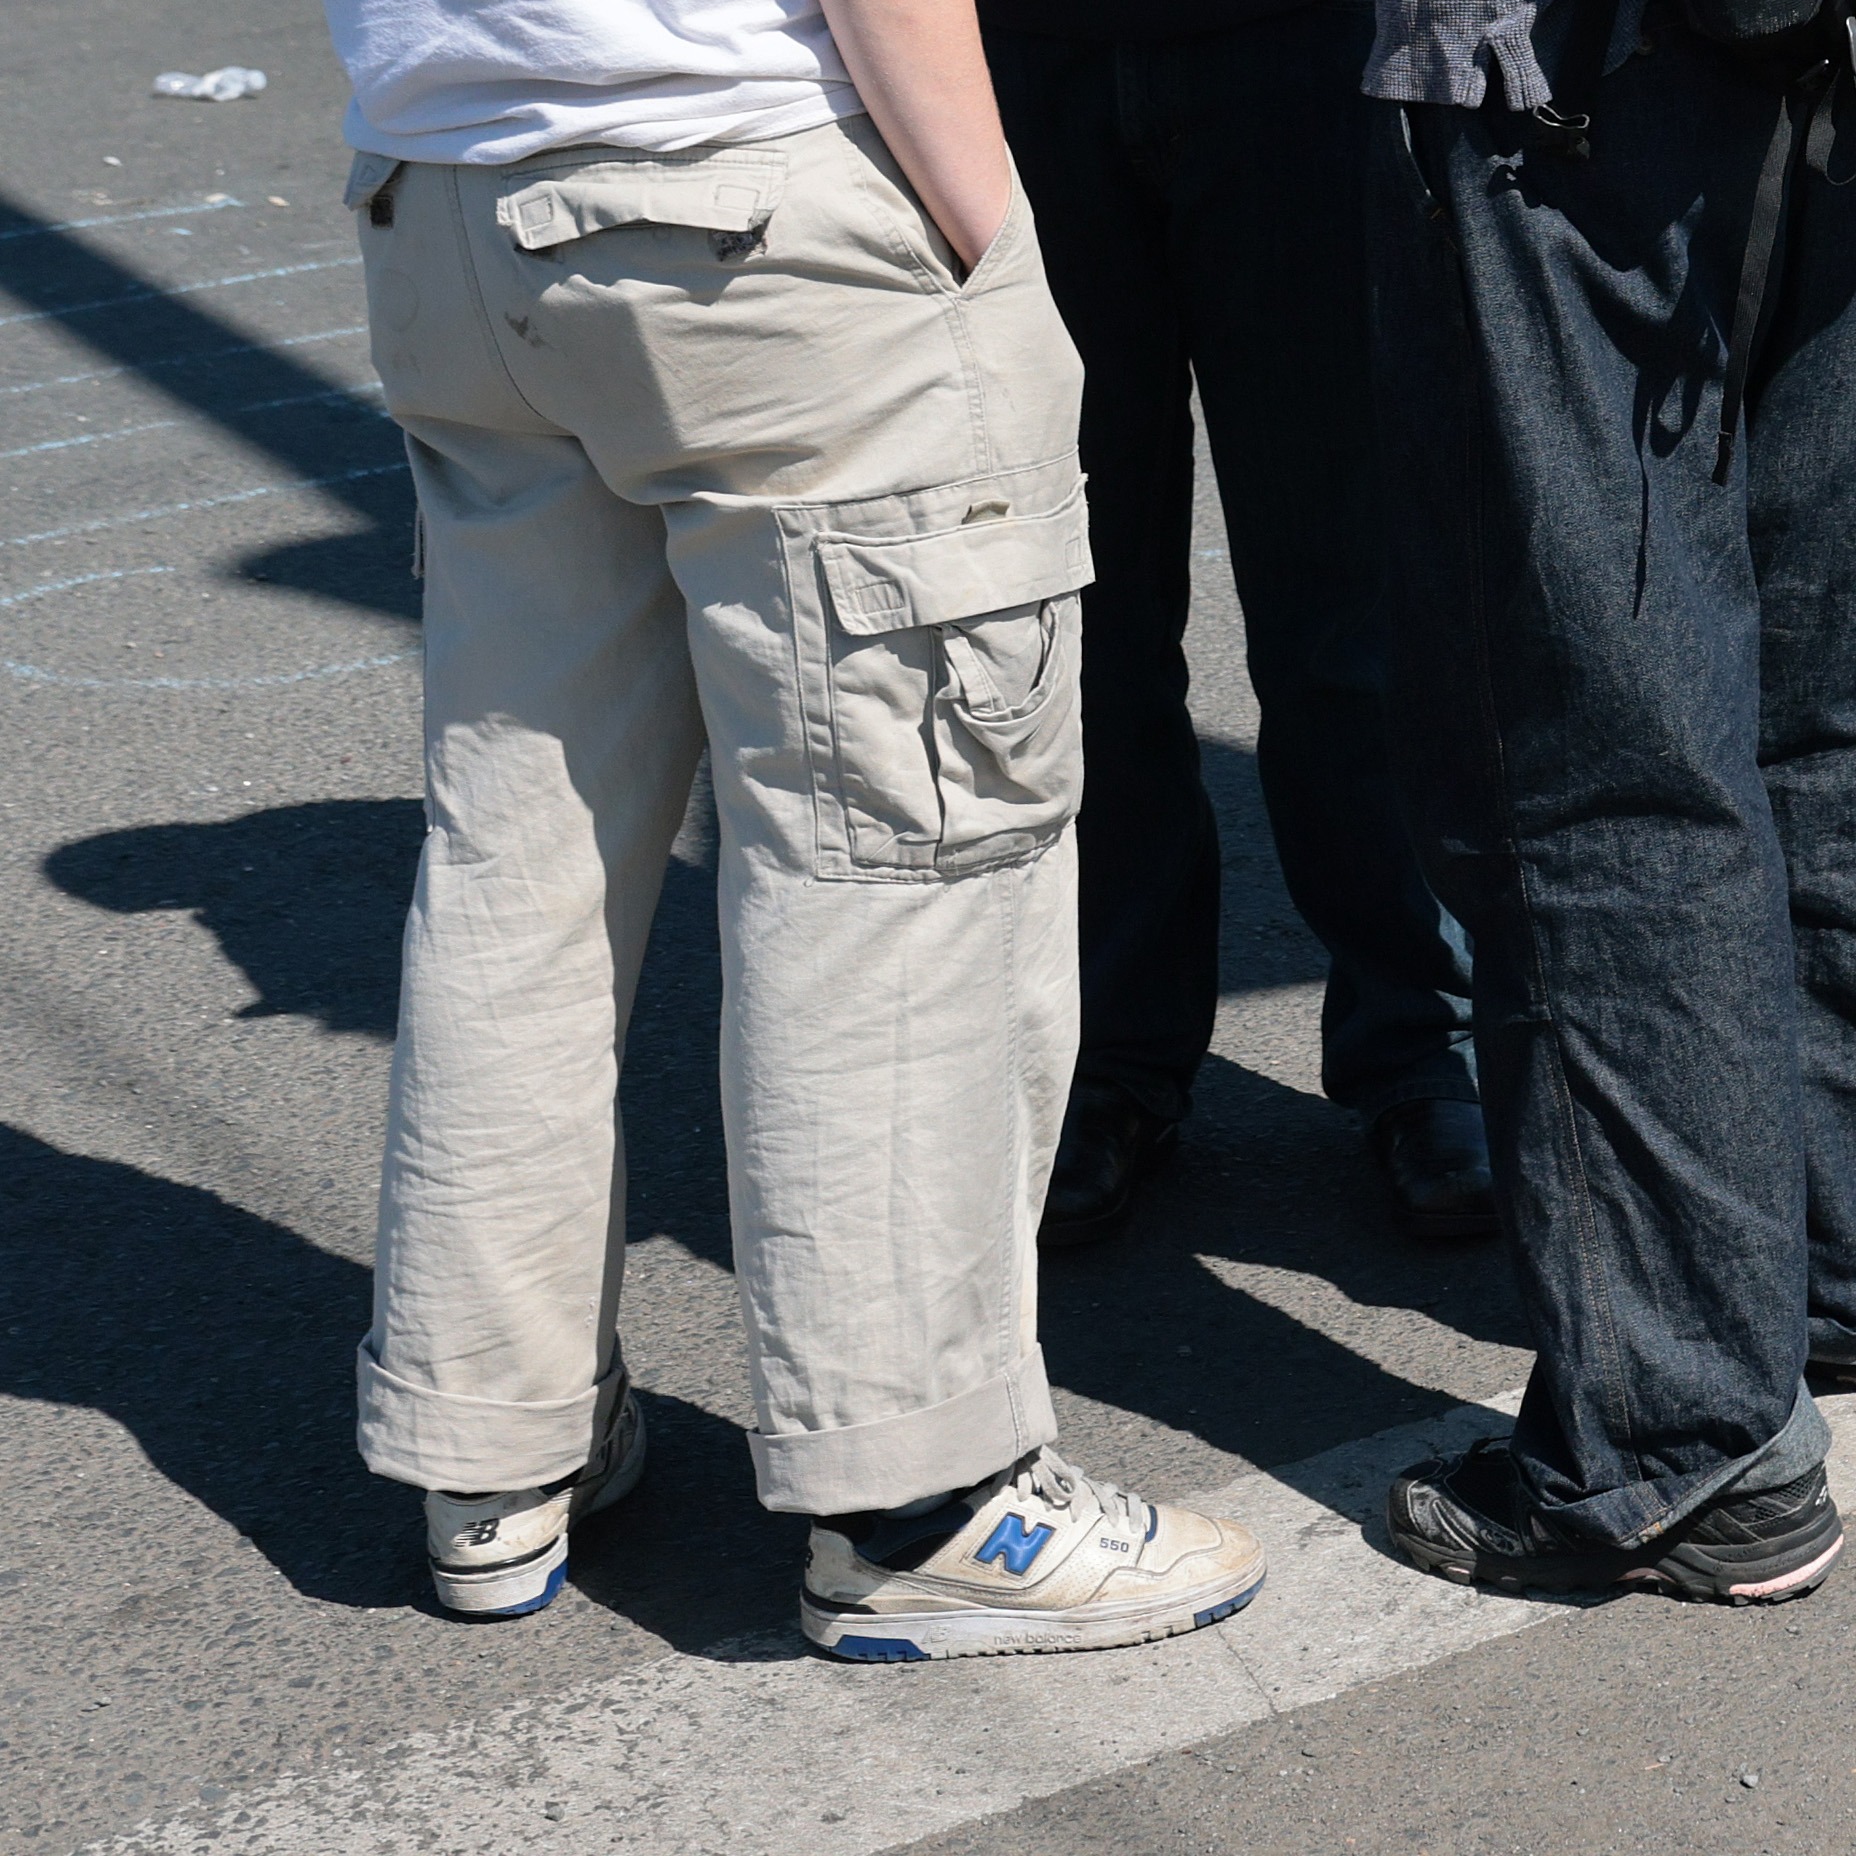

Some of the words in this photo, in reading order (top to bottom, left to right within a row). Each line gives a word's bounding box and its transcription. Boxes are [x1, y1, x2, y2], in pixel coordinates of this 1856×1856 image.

[1099, 1536, 1129, 1554] 550
[993, 1634, 1023, 1645] new
[1025, 1631, 1083, 1646] balance
